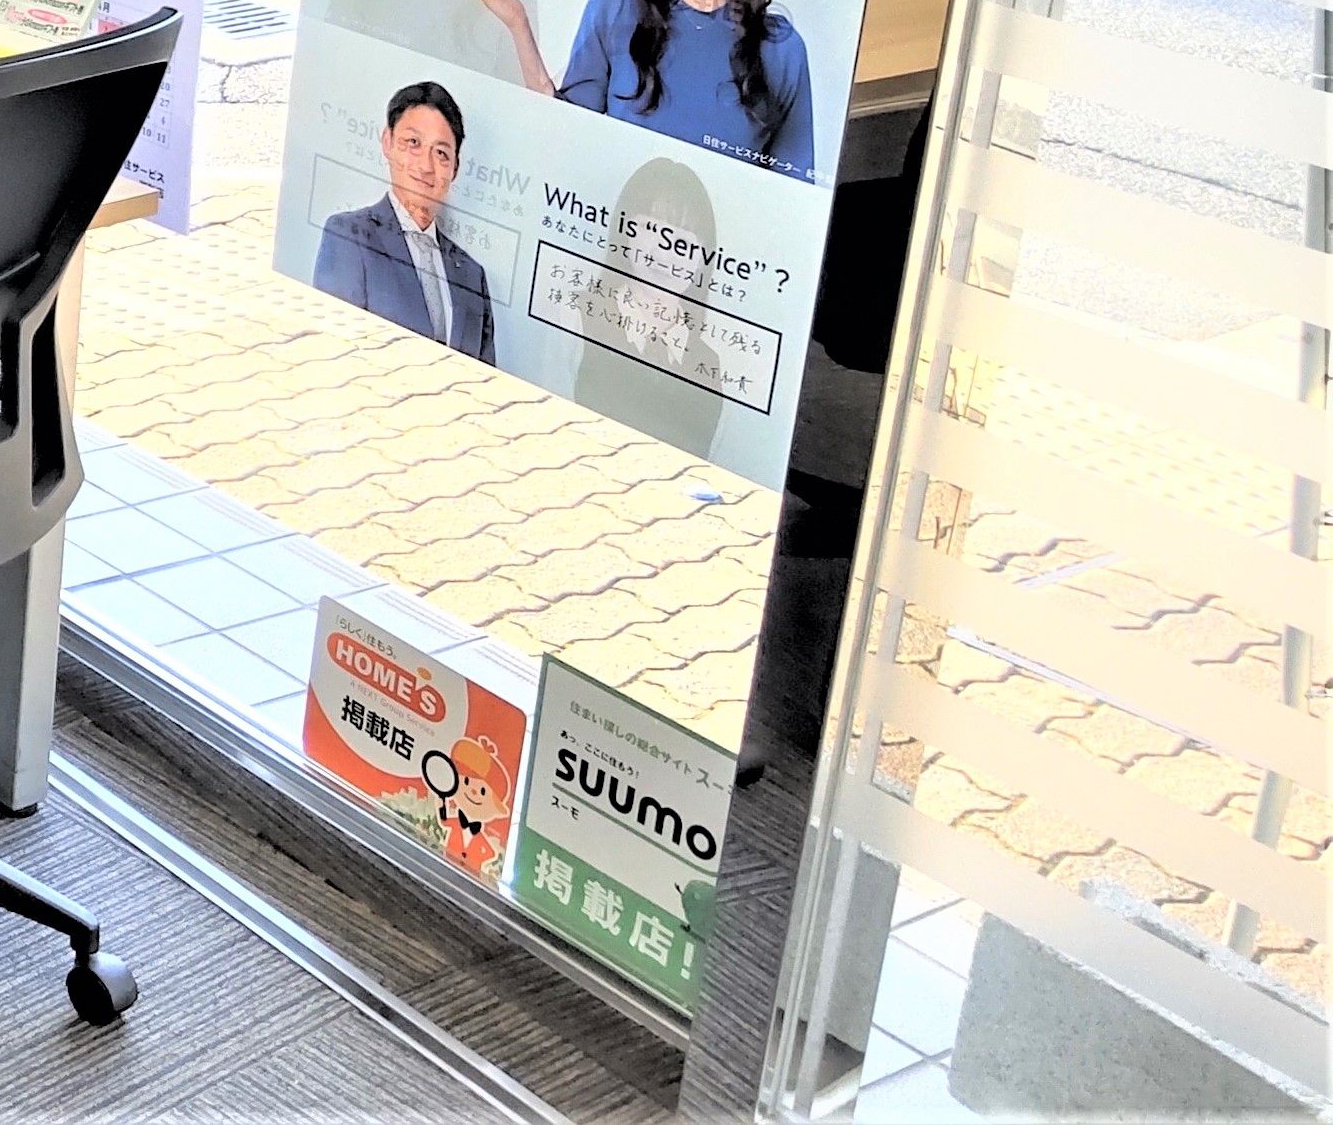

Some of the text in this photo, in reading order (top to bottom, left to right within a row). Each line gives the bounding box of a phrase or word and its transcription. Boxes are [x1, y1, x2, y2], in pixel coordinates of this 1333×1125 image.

[702, 133, 802, 174] 日住サービスナビゲーター
[542, 181, 609, 230] What
[617, 209, 638, 239] is
[340, 694, 415, 761] 掲載店
[569, 699, 692, 776] 住まい探しの総合サイト
[550, 794, 581, 821] スーモ
